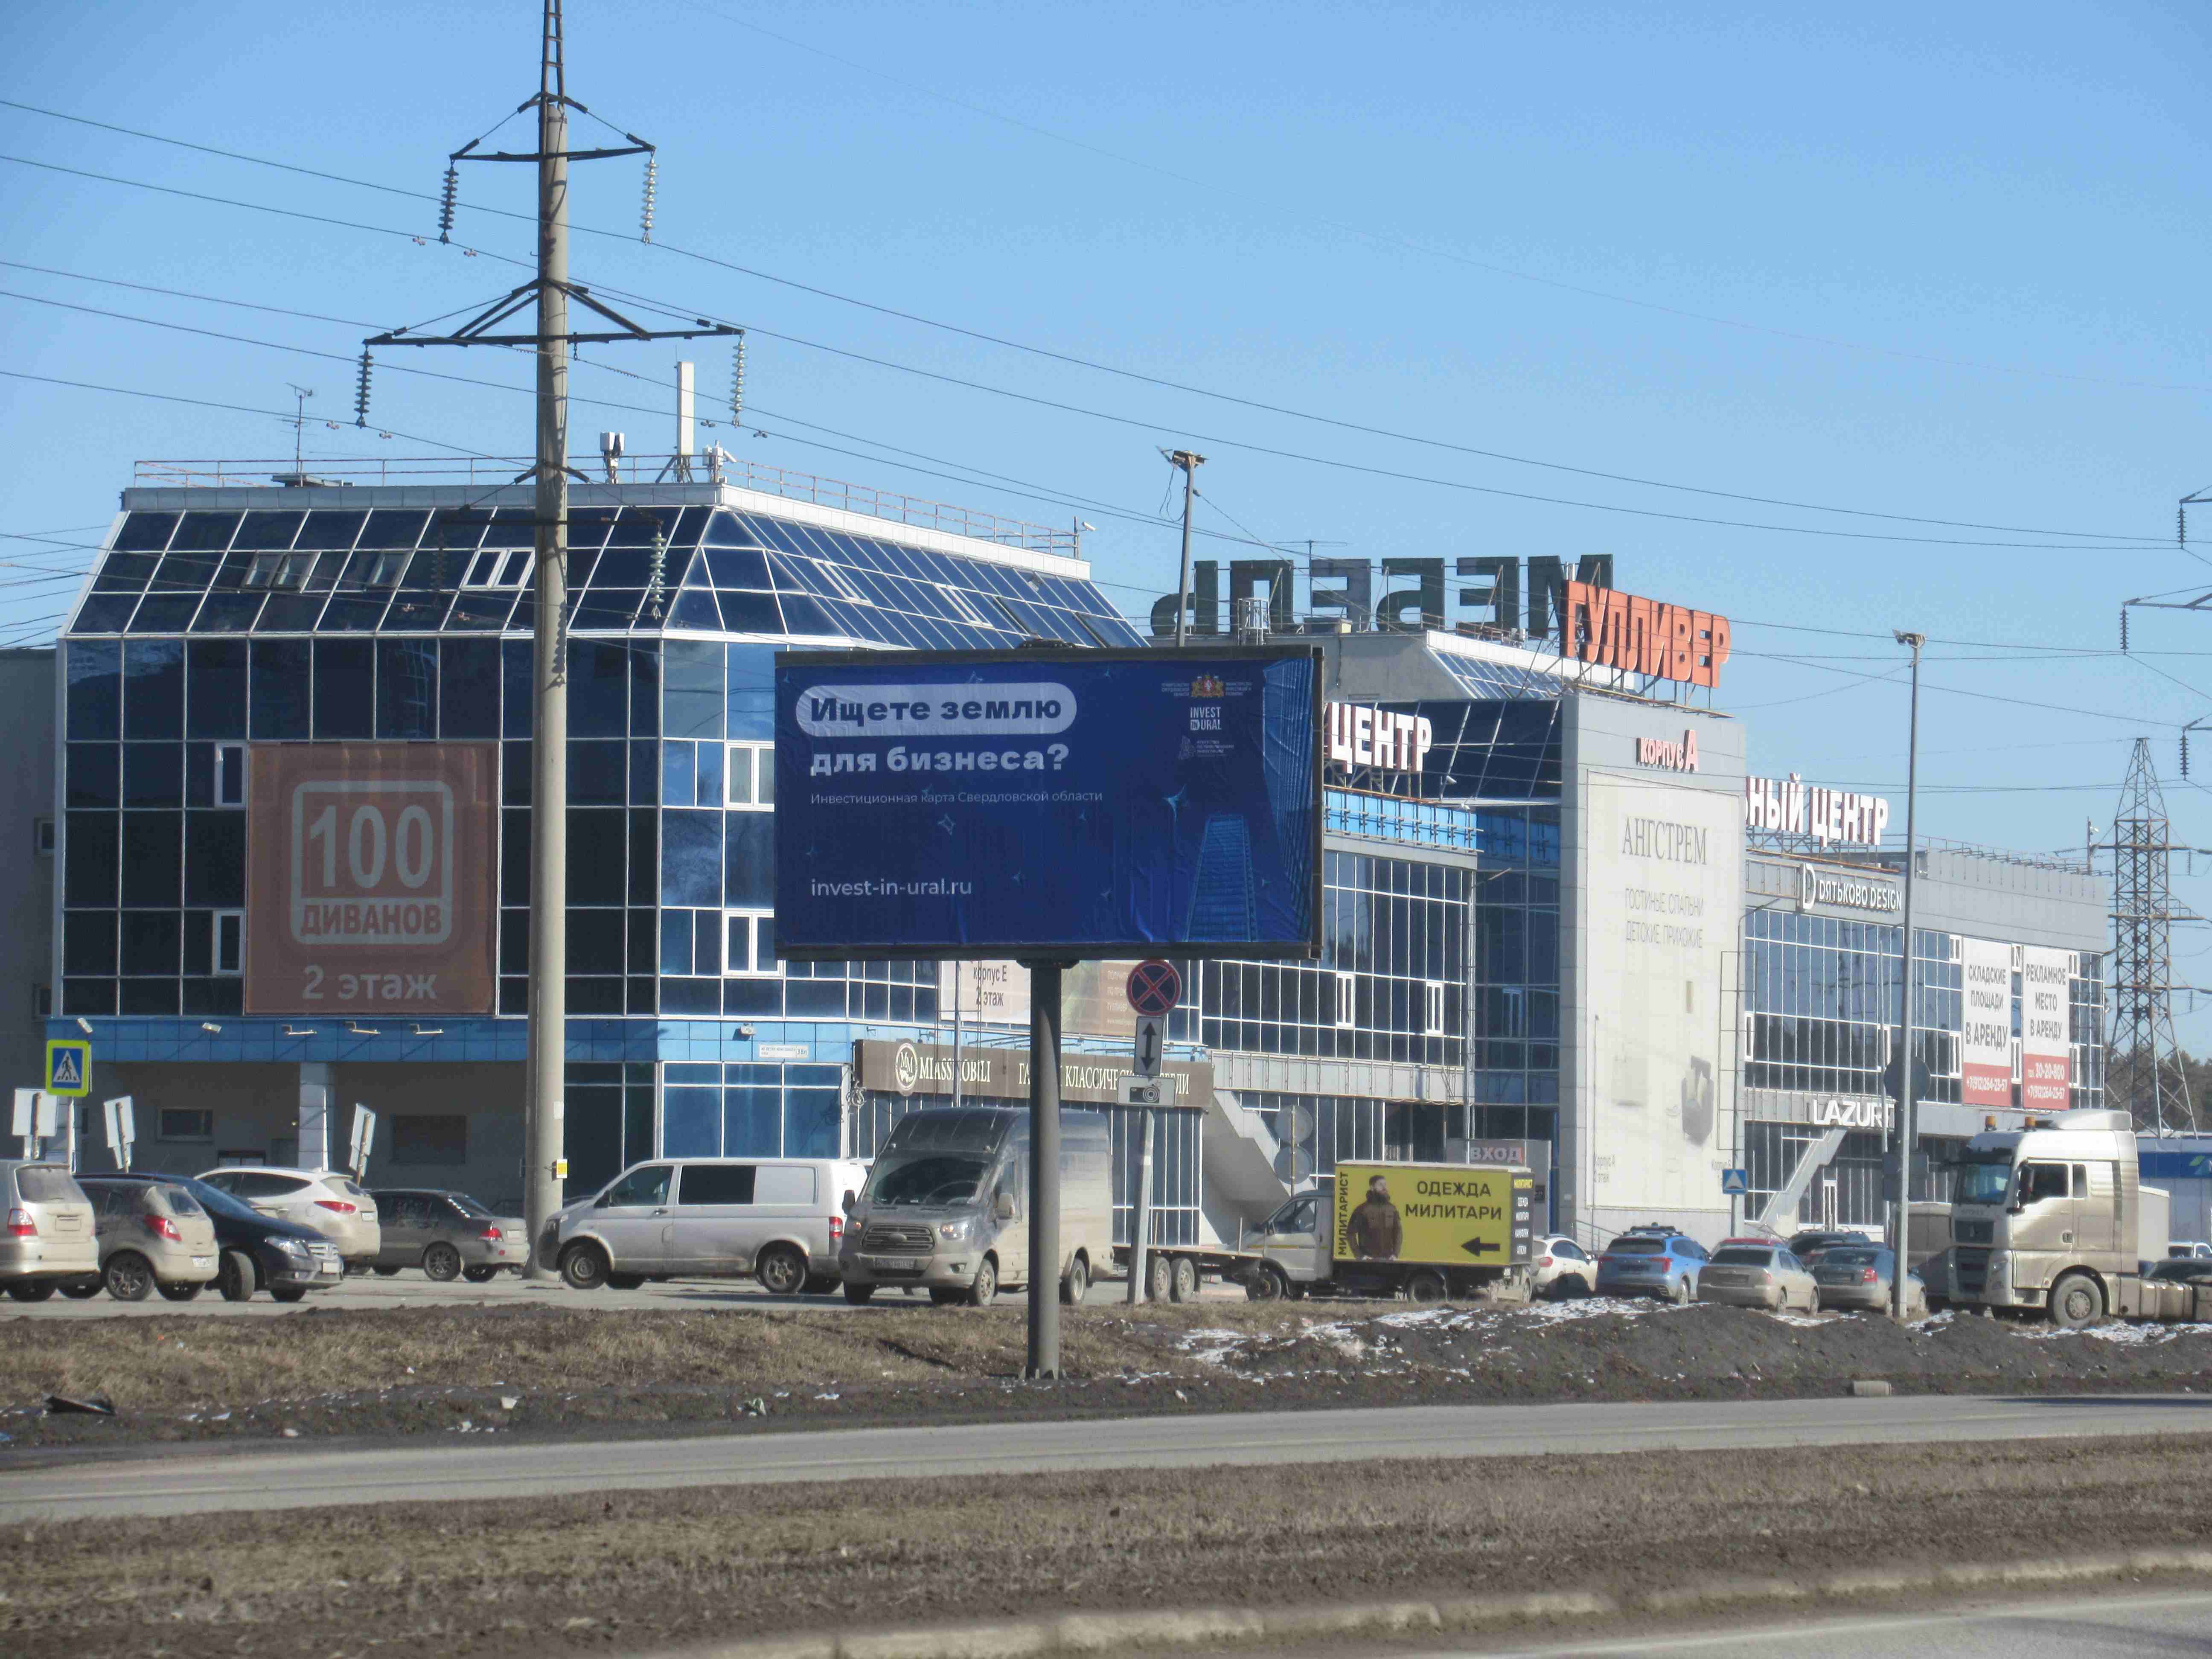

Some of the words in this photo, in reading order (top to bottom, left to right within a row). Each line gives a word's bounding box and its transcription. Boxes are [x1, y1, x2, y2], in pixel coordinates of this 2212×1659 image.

[1564, 579, 1731, 689] ГУЛЛИВЕР
[810, 699, 931, 725] Ищете
[940, 700, 1062, 721] землю
[1190, 707, 1222, 719] INVEST
[1200, 719, 1222, 731] URAL
[1330, 701, 1432, 774] ЦЕНТР
[810, 748, 876, 776] для
[886, 743, 1070, 772] бизнеса?
[1685, 729, 1700, 771] А
[810, 793, 918, 805] Инвестиционная
[920, 794, 955, 805] карта
[958, 792, 1049, 804] Свердловской
[1051, 792, 1103, 802] области
[1746, 773, 1804, 834] НЫЙ
[1811, 786, 1888, 847] ЦЕНТР
[309, 805, 434, 889] 100
[1622, 815, 1707, 865] АНГСТРЕМ
[810, 877, 972, 896] invest-in-ural.ru
[1870, 887, 1902, 911] DESIGN
[300, 904, 442, 937] ДИВАНОВ
[302, 964, 325, 1000] 2
[338, 972, 438, 1000] этаж
[973, 966, 1000, 985] корпус
[1968, 964, 2006, 985] СКЛАДСКИЕ
[2026, 963, 2066, 985] РЕКЛАМНОЕ
[983, 991, 1004, 1006] этаж
[1971, 990, 2003, 1011] ПЛОЩАДИ
[2035, 992, 2057, 1011] МЕСТО
[1966, 1022, 1971, 1045] В
[1973, 1022, 2008, 1051] АРЕНДУ
[2030, 1019, 2034, 1036] В
[2036, 1020, 2062, 1041] АРЕНДУ
[1470, 1147, 1523, 1164] ВХОД
[1417, 1180, 1491, 1198] ОДЕЖДА
[1338, 1171, 1349, 1256] МИЛИТАРИСТ
[1405, 1204, 1502, 1220] МИЛИТАРИ
